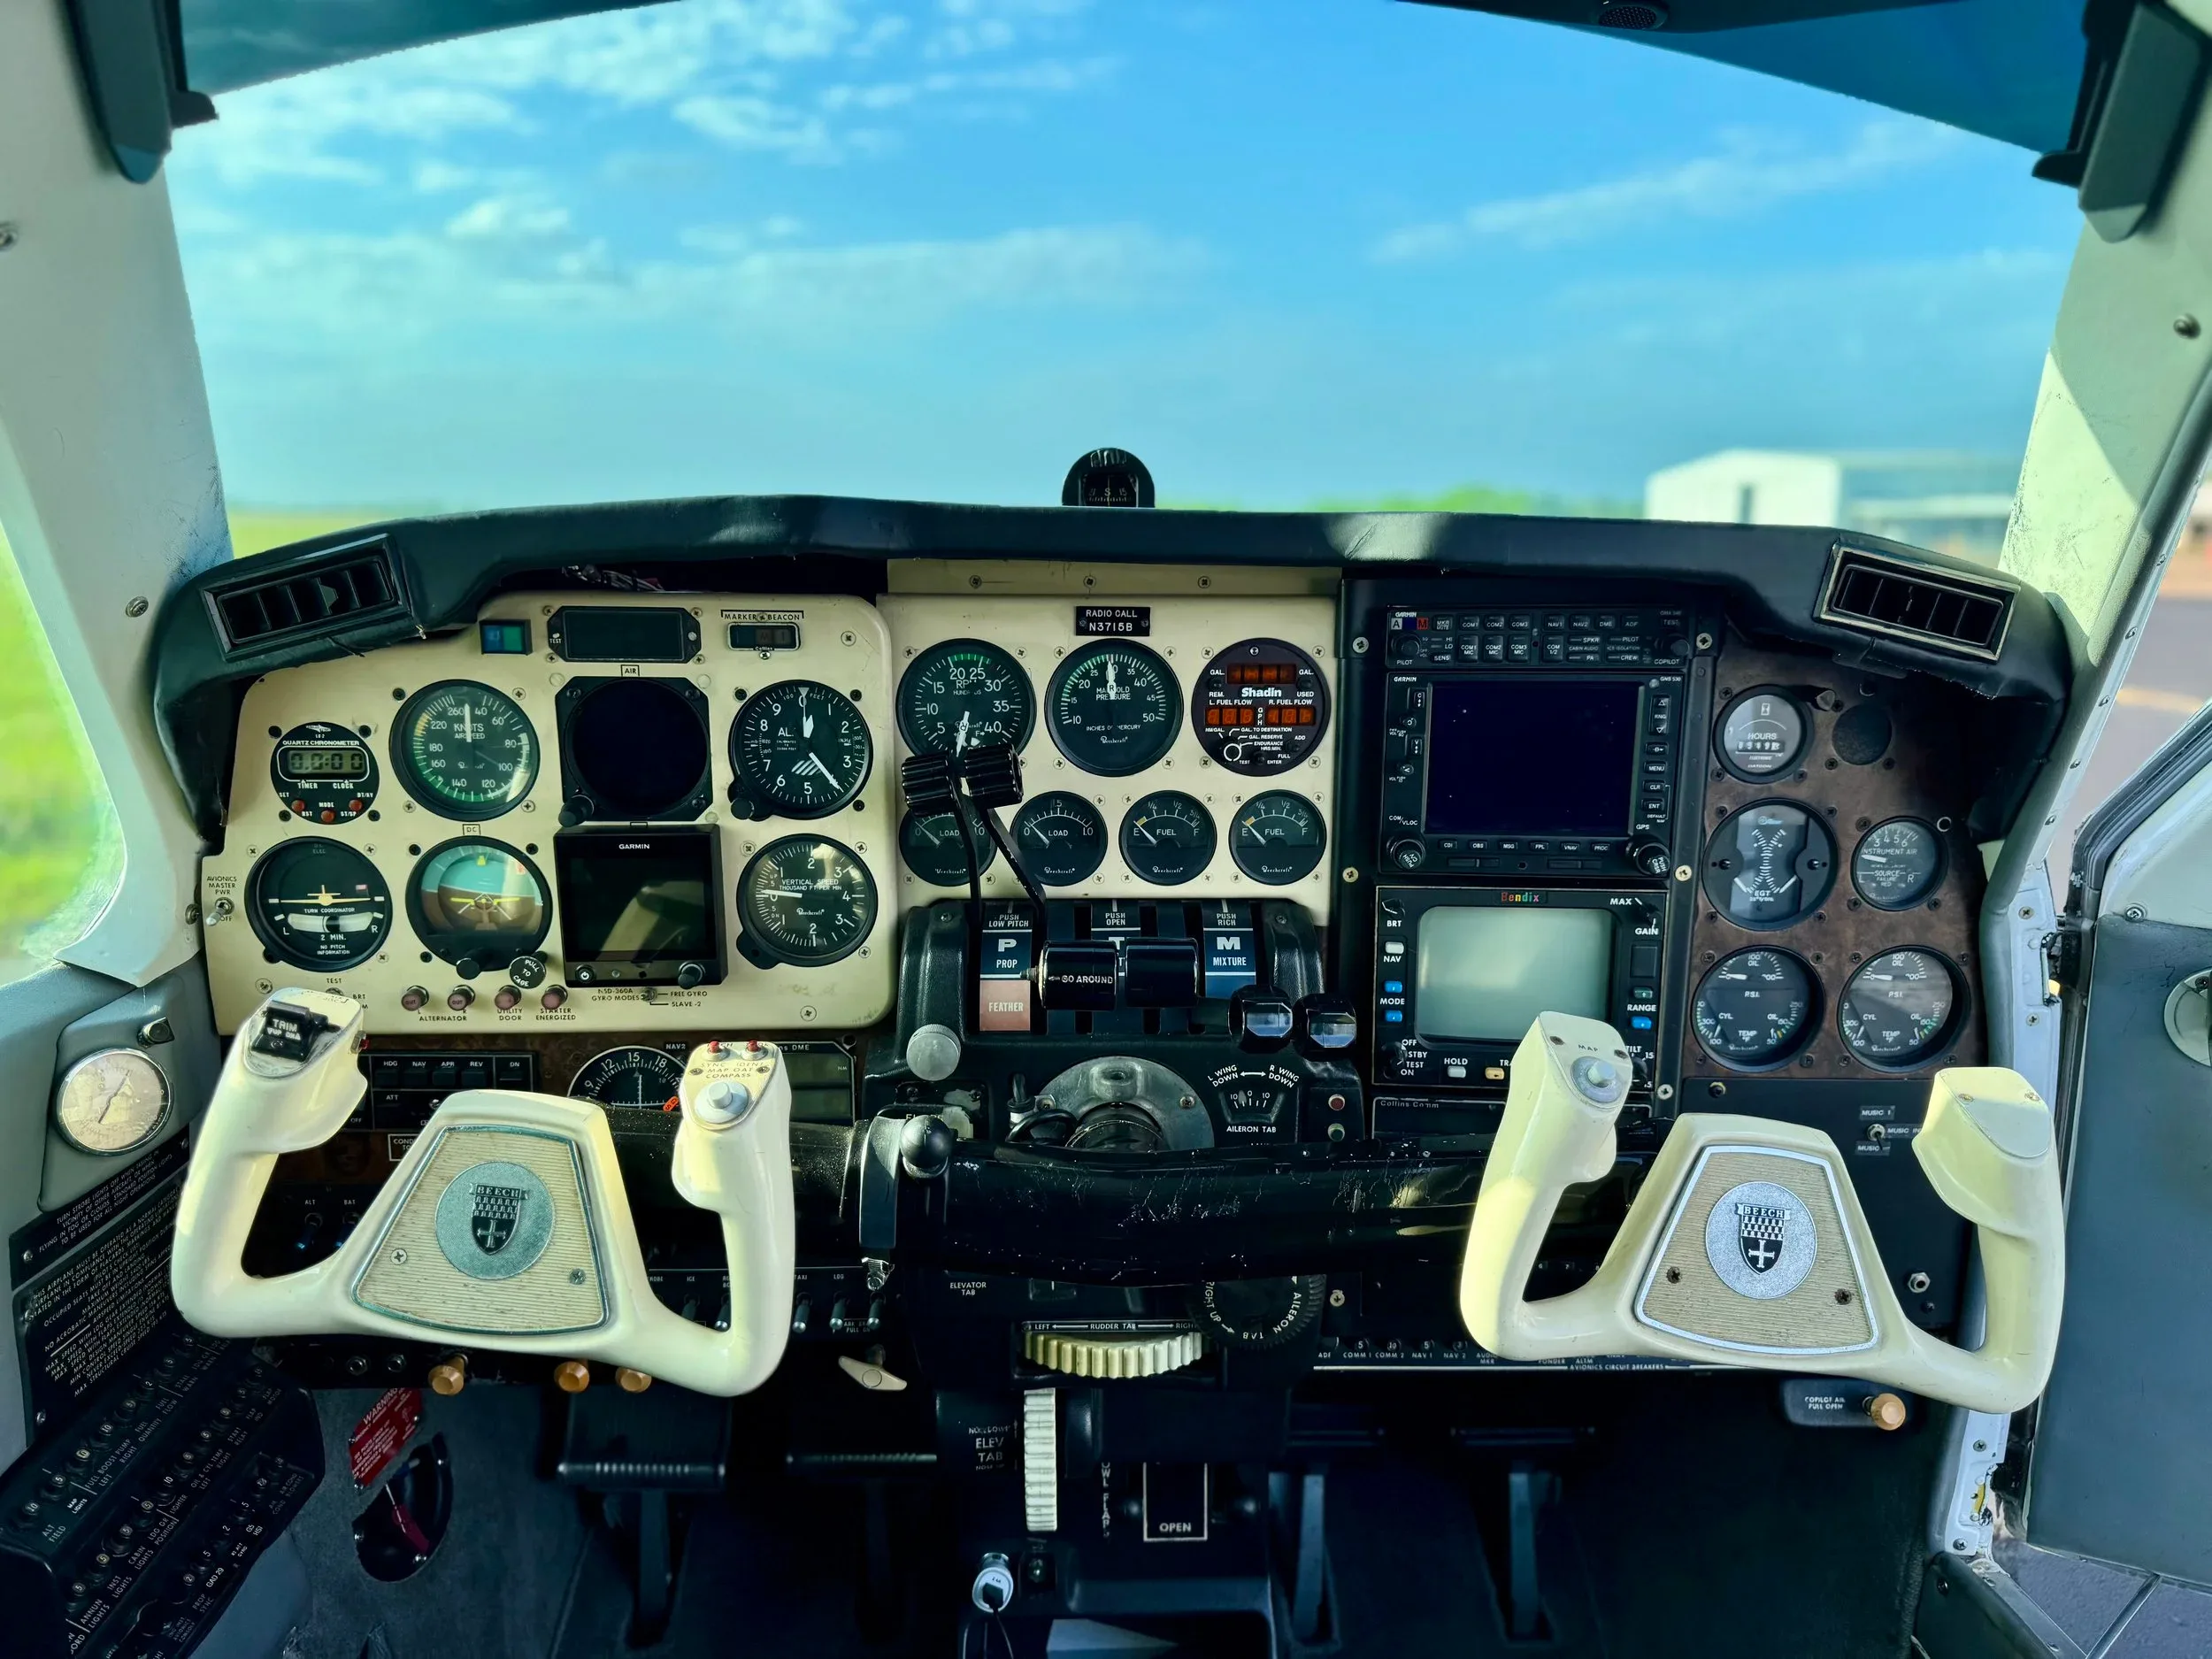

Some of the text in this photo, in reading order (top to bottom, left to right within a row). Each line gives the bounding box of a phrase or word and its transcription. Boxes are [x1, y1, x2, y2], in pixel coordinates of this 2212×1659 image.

[949, 668, 965, 680] 20
[970, 668, 986, 680] 25
[985, 680, 1001, 692] 30
[1241, 687, 1281, 697] Shadin
[993, 700, 1010, 712] 35
[1143, 713, 1155, 722] 50
[808, 858, 814, 869] 2
[833, 867, 841, 878] 3
[842, 891, 850, 901] 4
[1502, 892, 1539, 902] Bendix
[998, 939, 1017, 952] P
[1217, 937, 1240, 949] M
[525, 960, 539, 972] PULL
[996, 959, 1018, 968] PROP
[513, 975, 528, 987] CAGE
[989, 1002, 1023, 1011] FEATHER
[273, 1019, 297, 1032] TRIM
[628, 1052, 640, 1062] 15
[1215, 1064, 1238, 1076] WING
[1279, 1067, 1299, 1082] WING
[1212, 1072, 1238, 1087] DOWN
[1269, 1073, 1294, 1087] DOWN
[475, 1187, 520, 1196] BEECH
[1744, 1207, 1785, 1217] BEECH
[44, 1290, 88, 1327] OCCUPIED SEATS
[1273, 1292, 1302, 1333] AILERON
[44, 1316, 87, 1352] NO ACROBATIC
[976, 1438, 1002, 1448] ELEV
[979, 1453, 1003, 1462] TAB
[67, 1498, 77, 1509] MAP
[72, 1499, 88, 1514] LIGHTS
[42, 1525, 55, 1537] ALT
[49, 1525, 65, 1542] FIELD
[1160, 1523, 1191, 1532] OPEN
[128, 1546, 146, 1564] CABIN
[134, 1550, 154, 1570] LIGHTS
[107, 1575, 122, 1590] INST
[206, 1567, 224, 1587] GAD 29
[111, 1576, 133, 1598] LIGHTS
[81, 1599, 103, 1624] ANNUN
[88, 1604, 110, 1629] LIGHTS
